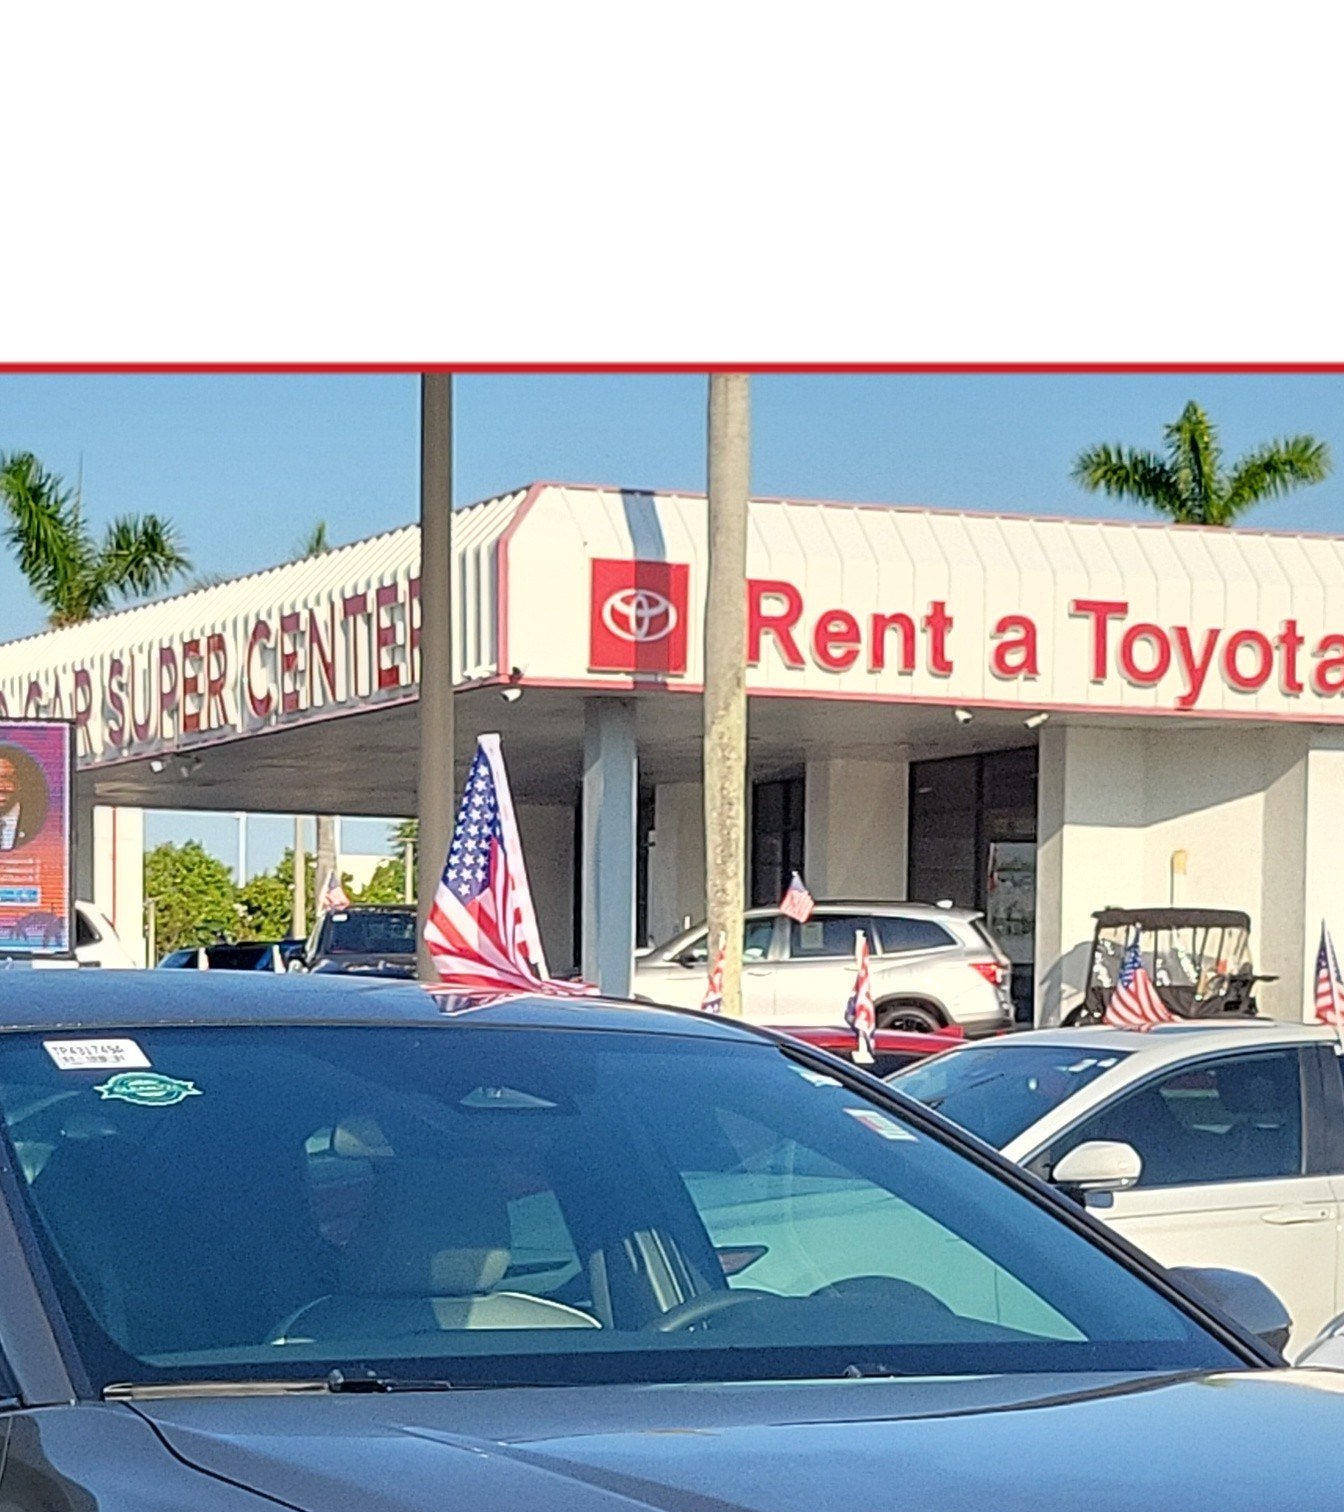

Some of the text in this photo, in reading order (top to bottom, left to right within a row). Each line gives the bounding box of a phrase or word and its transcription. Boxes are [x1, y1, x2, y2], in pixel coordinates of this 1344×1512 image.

[745, 578, 954, 675] Rent
[990, 613, 1039, 679] a
[108, 632, 235, 747] SUPER
